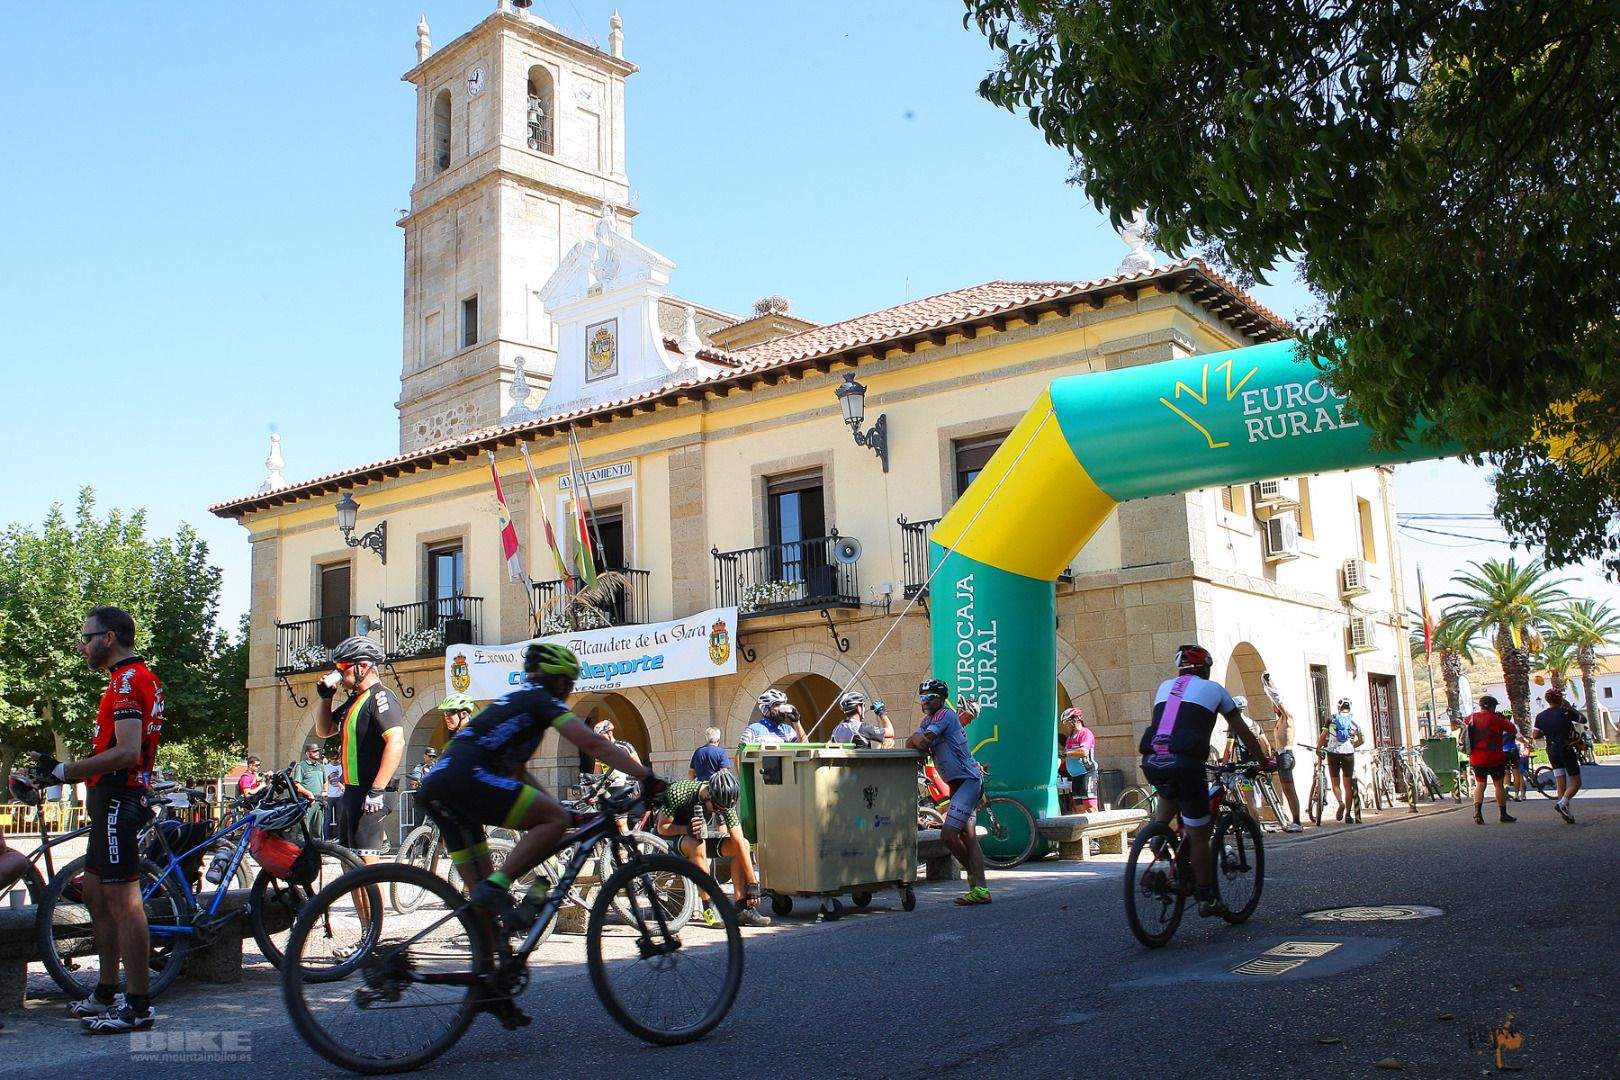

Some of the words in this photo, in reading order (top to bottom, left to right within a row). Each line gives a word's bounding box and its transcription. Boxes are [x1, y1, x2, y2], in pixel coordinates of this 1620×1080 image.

[1244, 404, 1360, 443] RURAL
[566, 635, 631, 656] Alcaudete
[635, 634, 650, 648] de
[654, 631, 669, 645] la
[580, 654, 664, 682] deporte
[977, 620, 998, 709] RURAL
